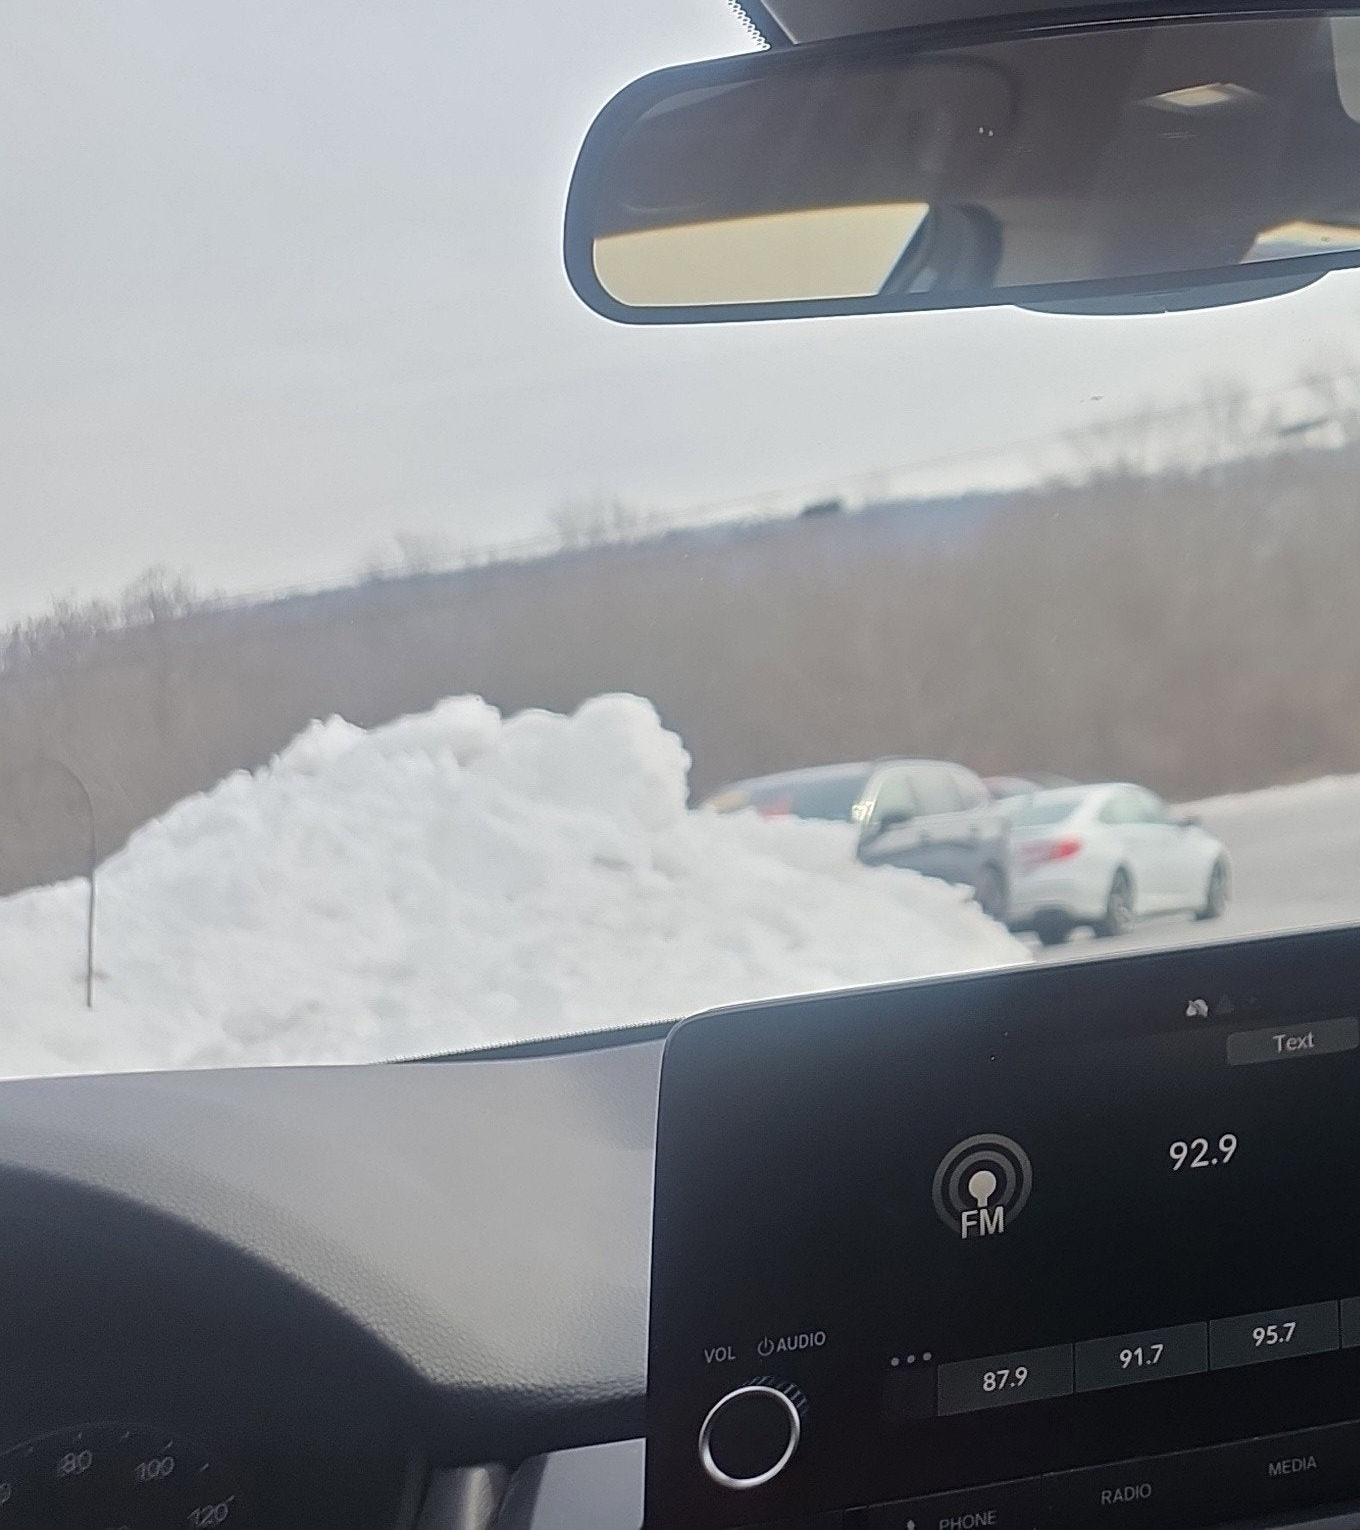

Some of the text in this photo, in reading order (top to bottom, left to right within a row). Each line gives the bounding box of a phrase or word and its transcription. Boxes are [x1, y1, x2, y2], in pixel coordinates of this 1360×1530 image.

[1273, 1031, 1315, 1054] Text
[1169, 1133, 1238, 1171] 92.9
[961, 1206, 1005, 1239] FM
[776, 1331, 827, 1353] AUDIO
[1252, 1322, 1297, 1347] 95.7
[704, 1345, 736, 1363] VOL
[1119, 1344, 1164, 1369] 91.7
[982, 1366, 1028, 1392] 87.9
[1268, 1455, 1317, 1477] MEDIA
[1101, 1483, 1152, 1505] RADIO
[938, 1510, 997, 1530] PHONE
